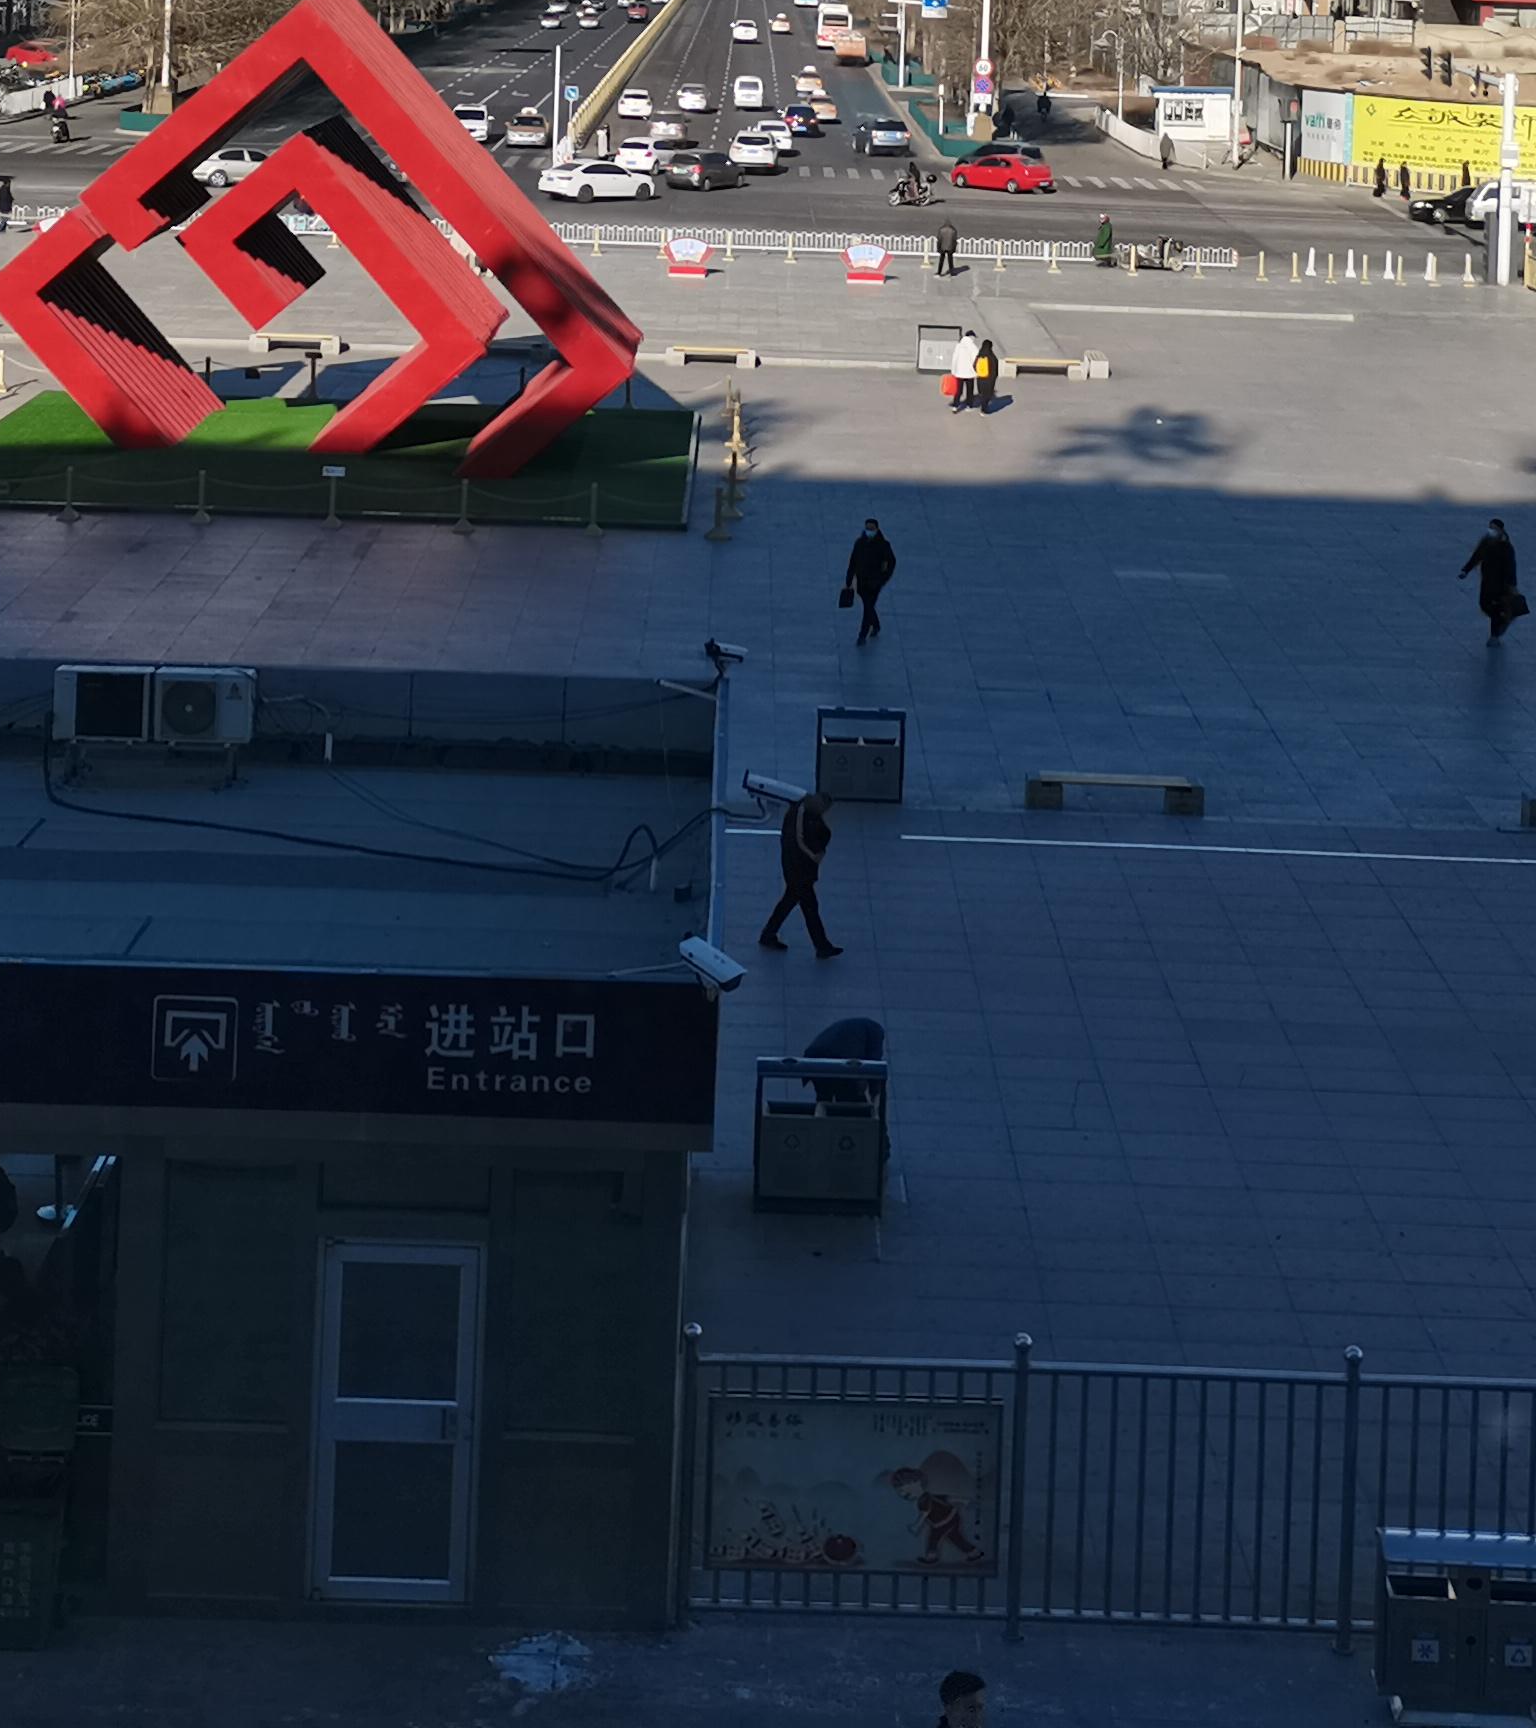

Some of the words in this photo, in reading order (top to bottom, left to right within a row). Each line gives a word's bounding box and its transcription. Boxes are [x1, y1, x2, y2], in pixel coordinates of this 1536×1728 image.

[424, 1003, 597, 1061] 进站口
[426, 1065, 593, 1093] Entrance
